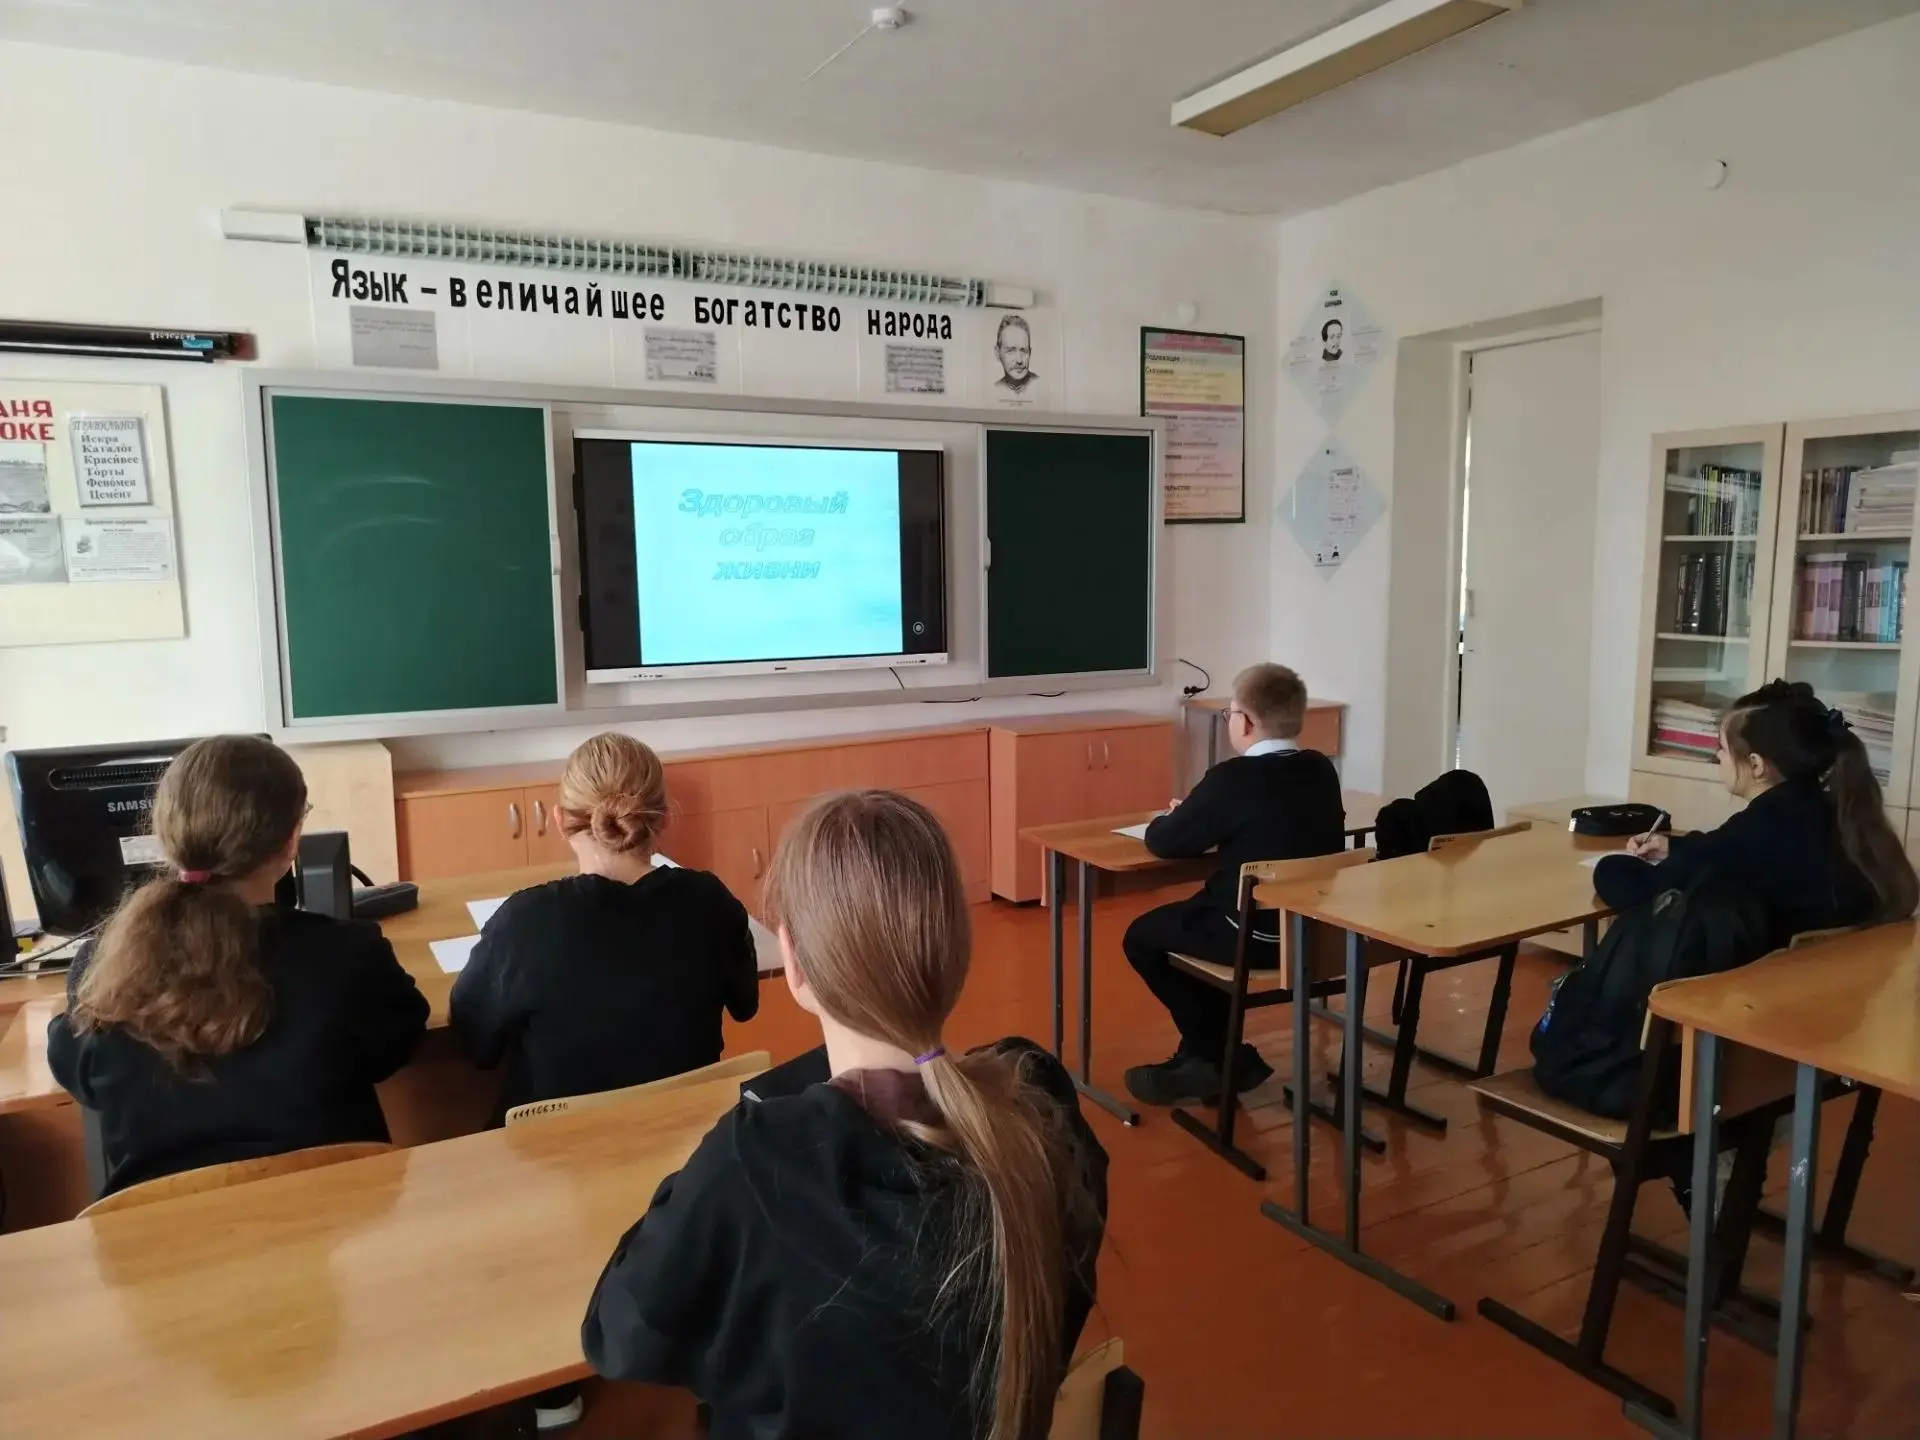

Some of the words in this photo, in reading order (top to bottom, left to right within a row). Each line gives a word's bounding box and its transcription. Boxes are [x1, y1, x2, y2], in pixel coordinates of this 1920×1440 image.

[331, 258, 409, 304] Язык
[449, 277, 665, 321] величайшее
[867, 309, 952, 340] народа
[678, 488, 849, 519] Здоровый
[719, 522, 816, 552] образ
[712, 561, 822, 581] жизни
[107, 799, 154, 813] SAMSU
